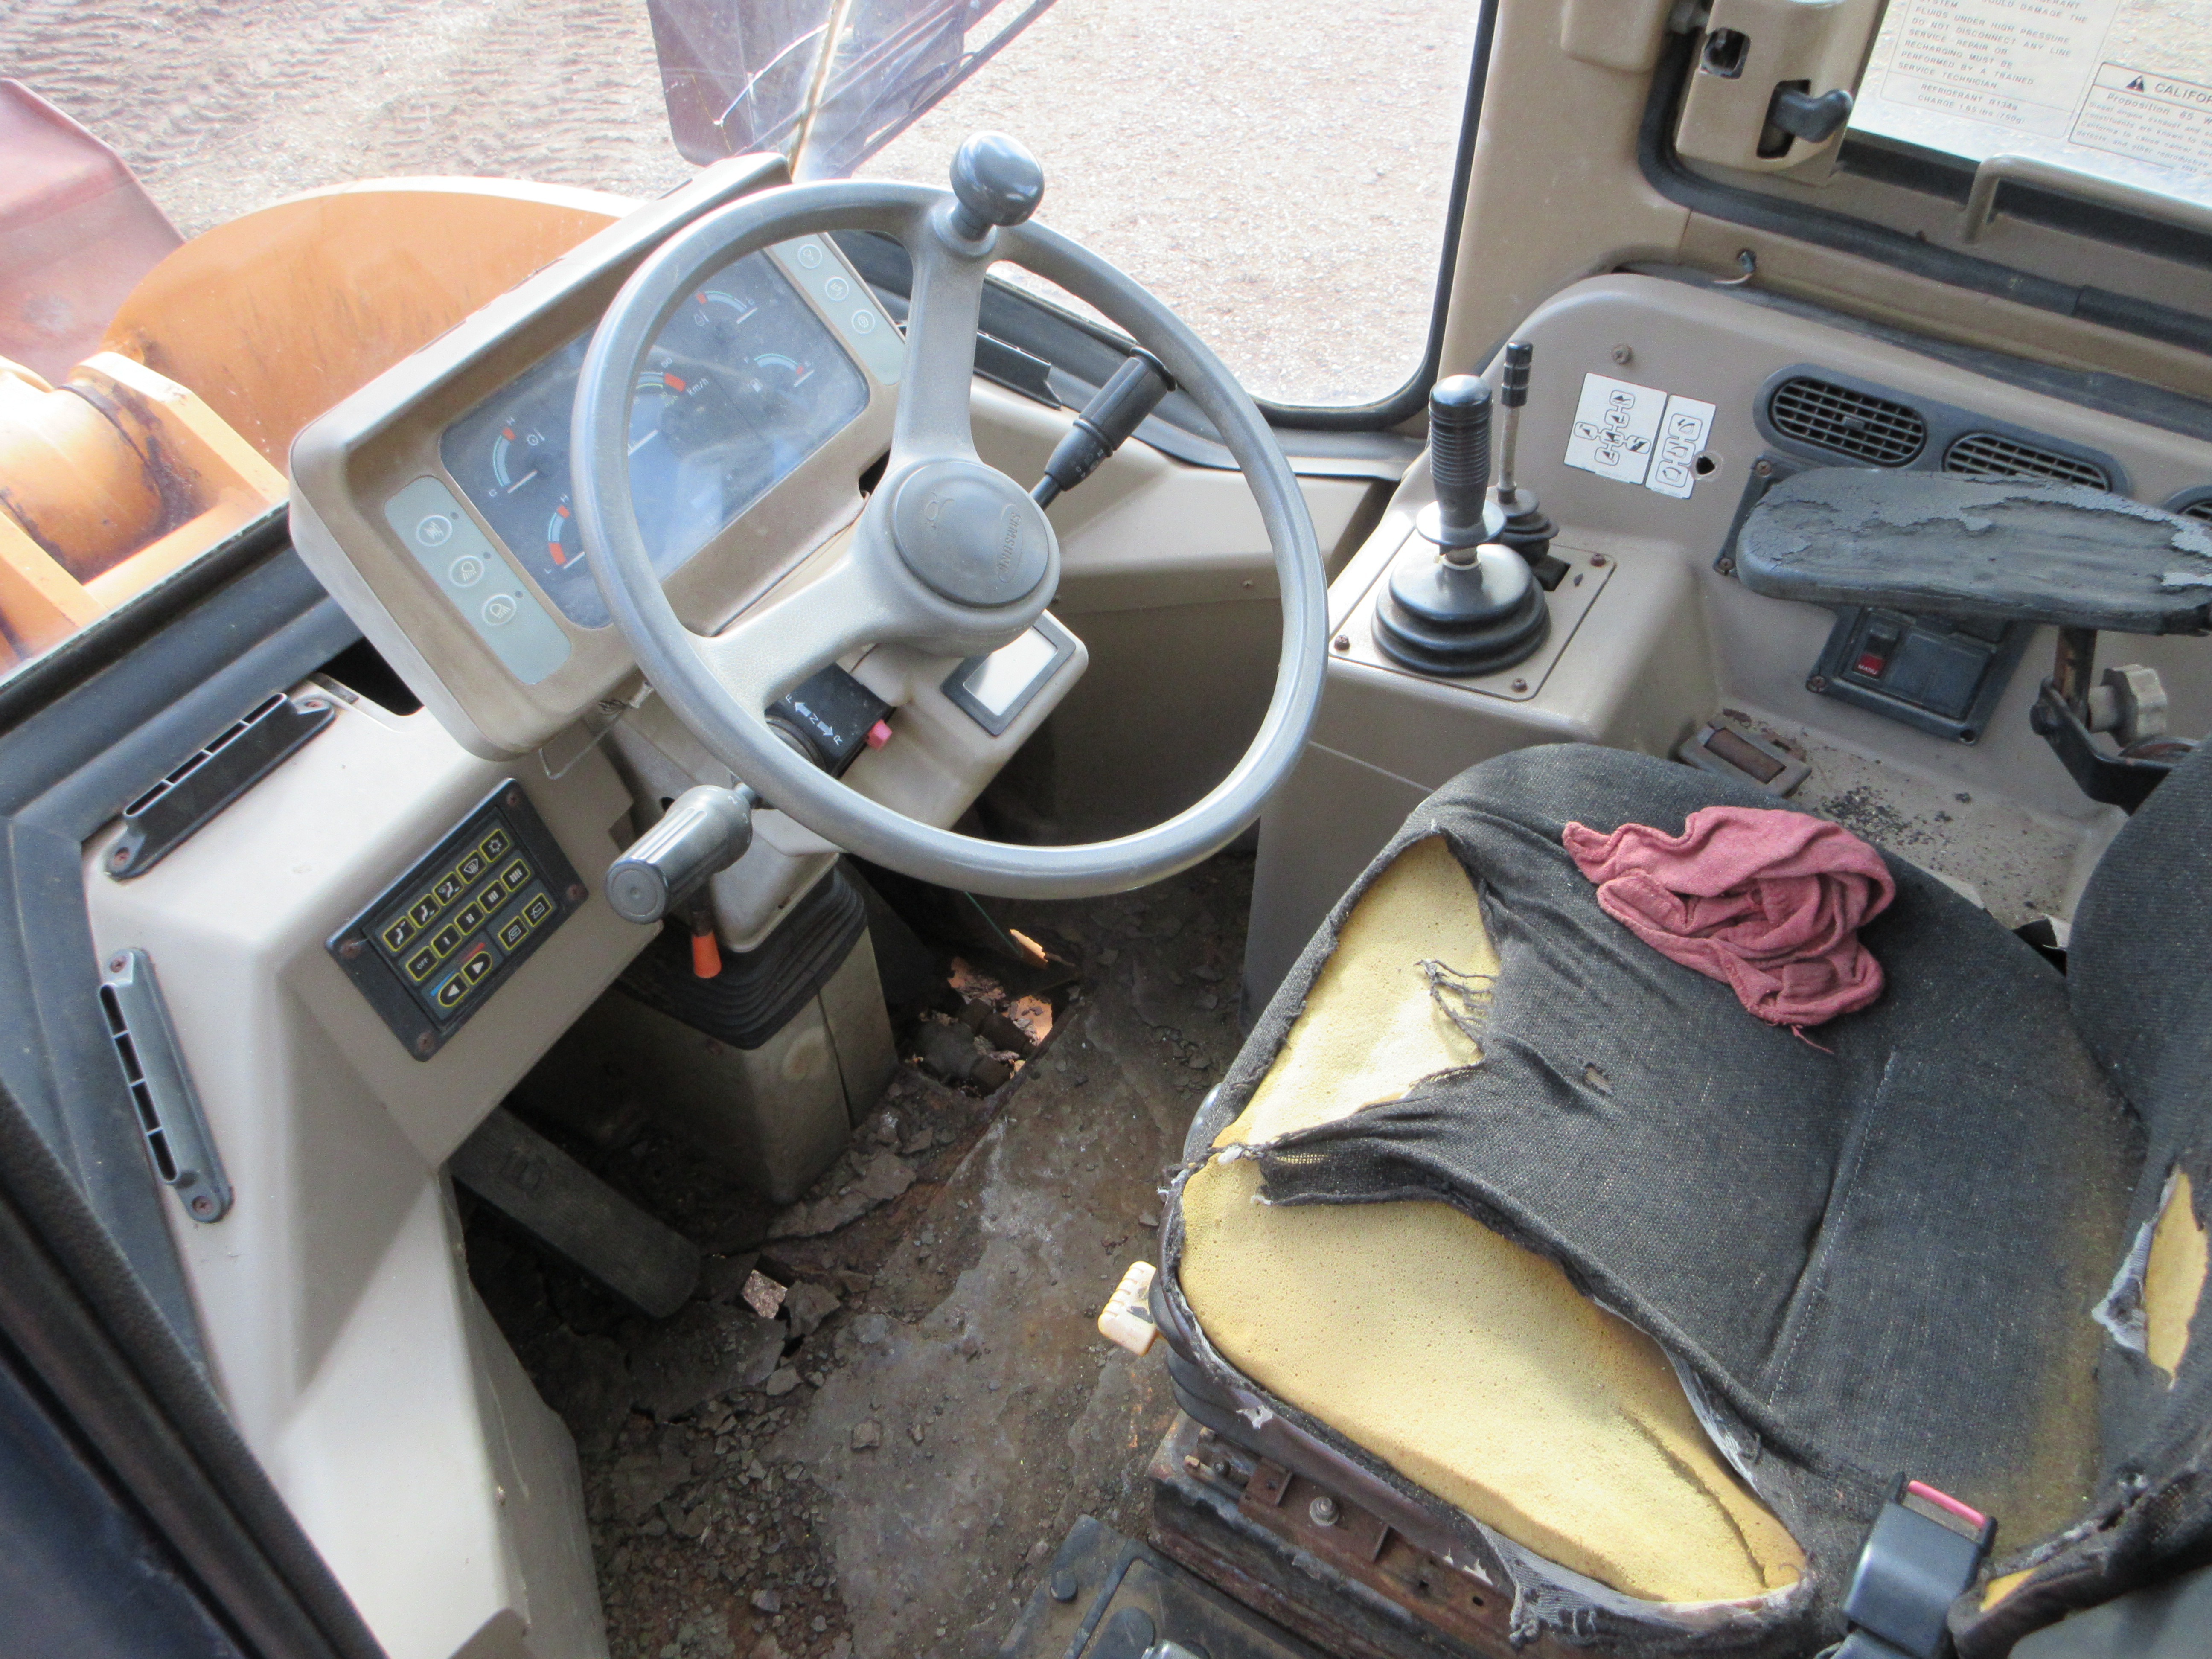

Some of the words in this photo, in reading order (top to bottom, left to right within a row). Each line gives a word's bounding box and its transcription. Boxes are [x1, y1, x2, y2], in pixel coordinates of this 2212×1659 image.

[1915, 6, 1949, 18] FLUIDS
[1953, 15, 1987, 26] UNDER
[1991, 22, 2015, 32] HIGH
[2020, 3, 2061, 18] DAMAGE
[2070, 14, 2088, 23] THE
[1912, 17, 1925, 26] DO
[1930, 21, 1950, 31] NOT
[1956, 26, 2016, 45] DISCONNECT
[2023, 41, 2044, 50] ANY
[1905, 40, 1963, 58] RECHARGING
[1969, 53, 1994, 64] MUST
[2000, 59, 2013, 69] BE
[1956, 39, 1989, 51] REPAIR
[1994, 47, 2008, 55] OR
[1898, 61, 1935, 76] SERVICE
[1942, 71, 1998, 89] TECHNICIAN
[1901, 50, 1955, 68] PERFORMED
[1961, 64, 1973, 72] BY
[1994, 71, 2035, 85] TRAINED
[1918, 94, 1954, 108] CHARGE
[1921, 83, 1983, 102] REFRIGERANT
[2107, 93, 2171, 114] Proposition
[687, 378, 710, 397] km/h
[998, 512, 1022, 573] SAMSUNG
[785, 694, 792, 704] F
[833, 735, 843, 746] R
[417, 958, 428, 969] OFF
